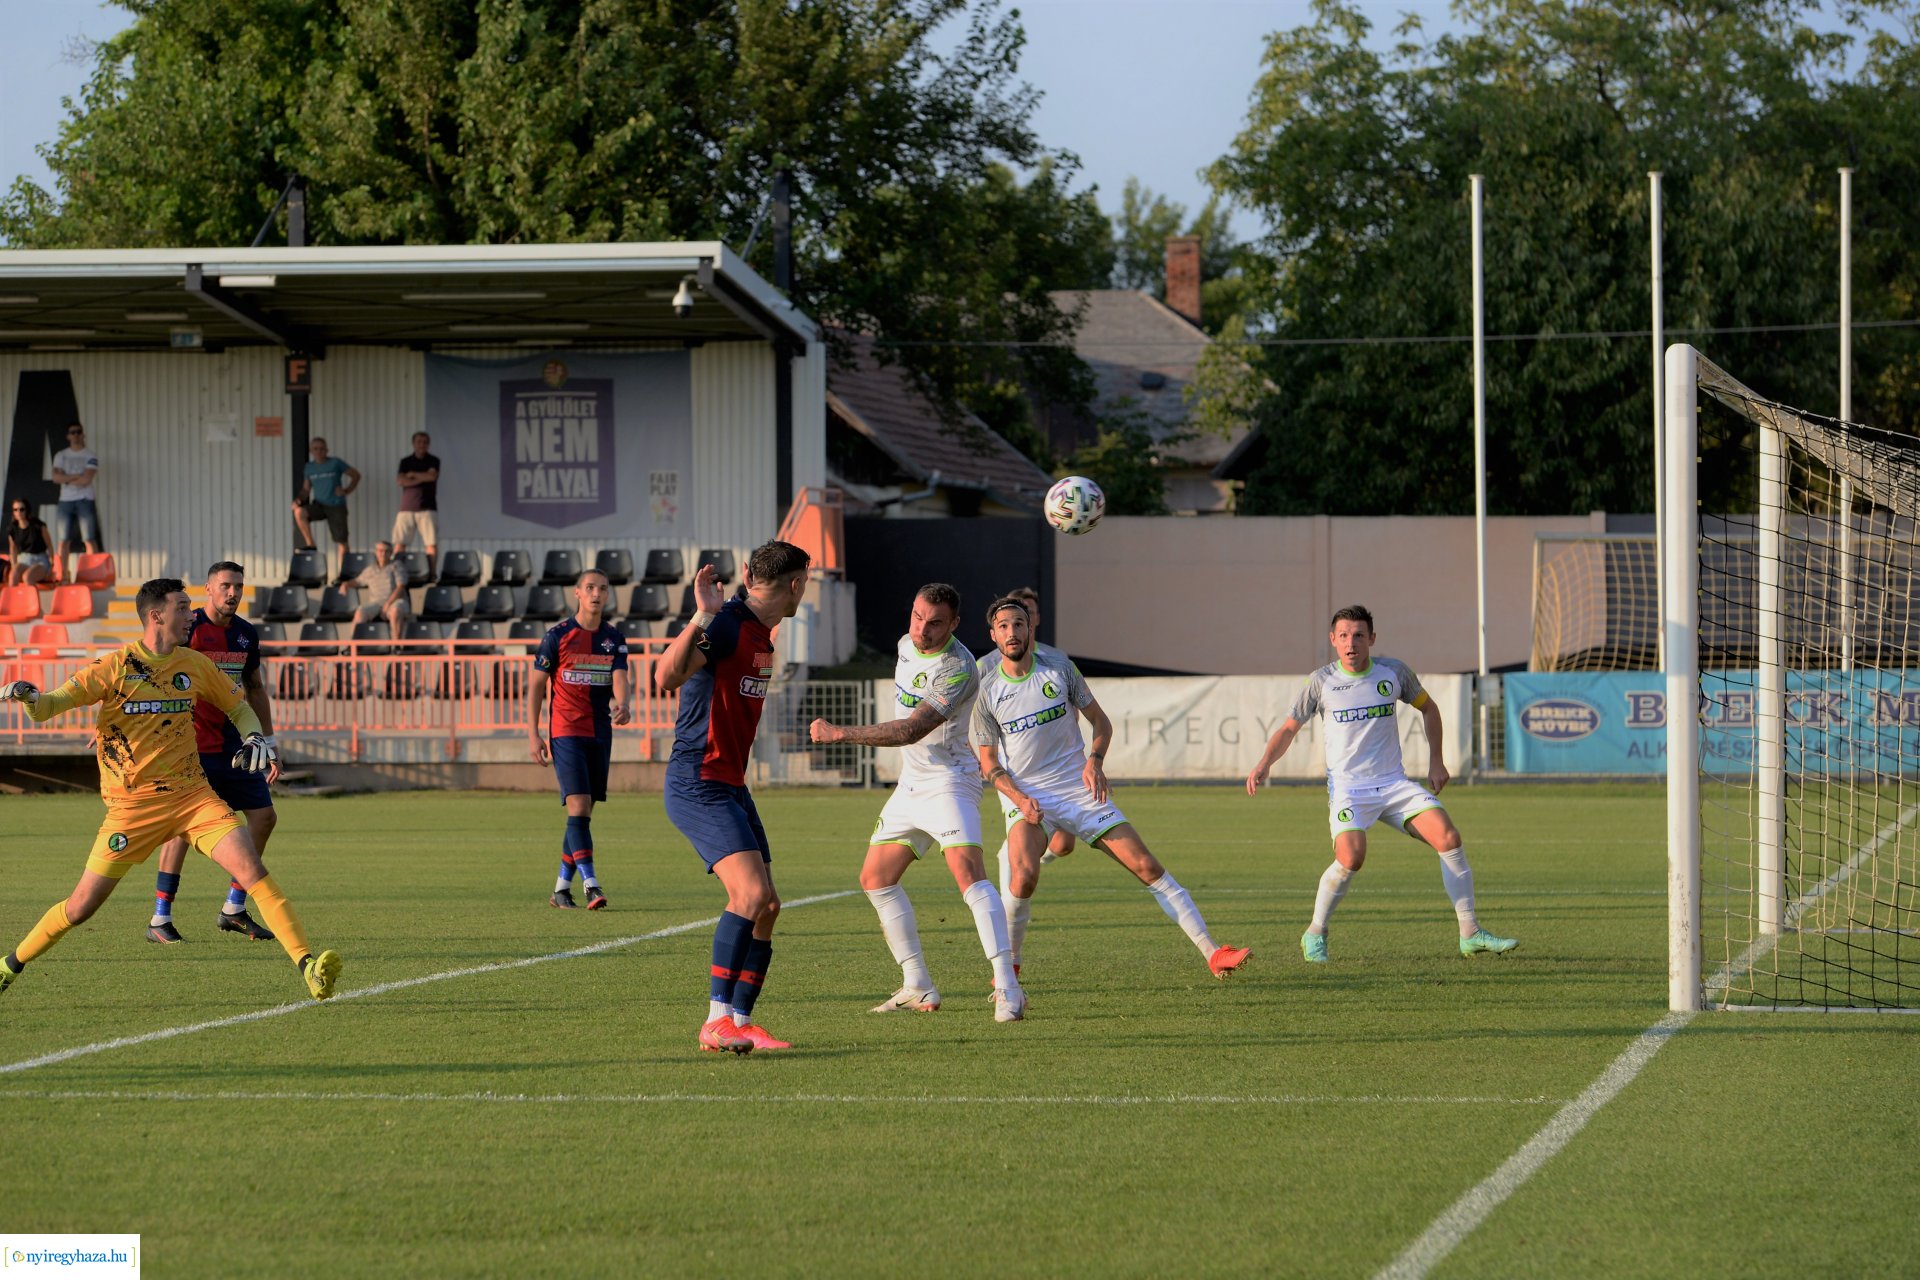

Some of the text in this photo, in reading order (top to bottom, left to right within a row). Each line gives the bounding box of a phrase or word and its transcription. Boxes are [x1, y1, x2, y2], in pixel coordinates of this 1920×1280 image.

[289, 359, 307, 384] F
[516, 400, 527, 418] A
[515, 418, 599, 463] NEM
[517, 463, 599, 498] PÁLYA!
[650, 472, 678, 484] FAIR
[650, 485, 677, 496] PLAY
